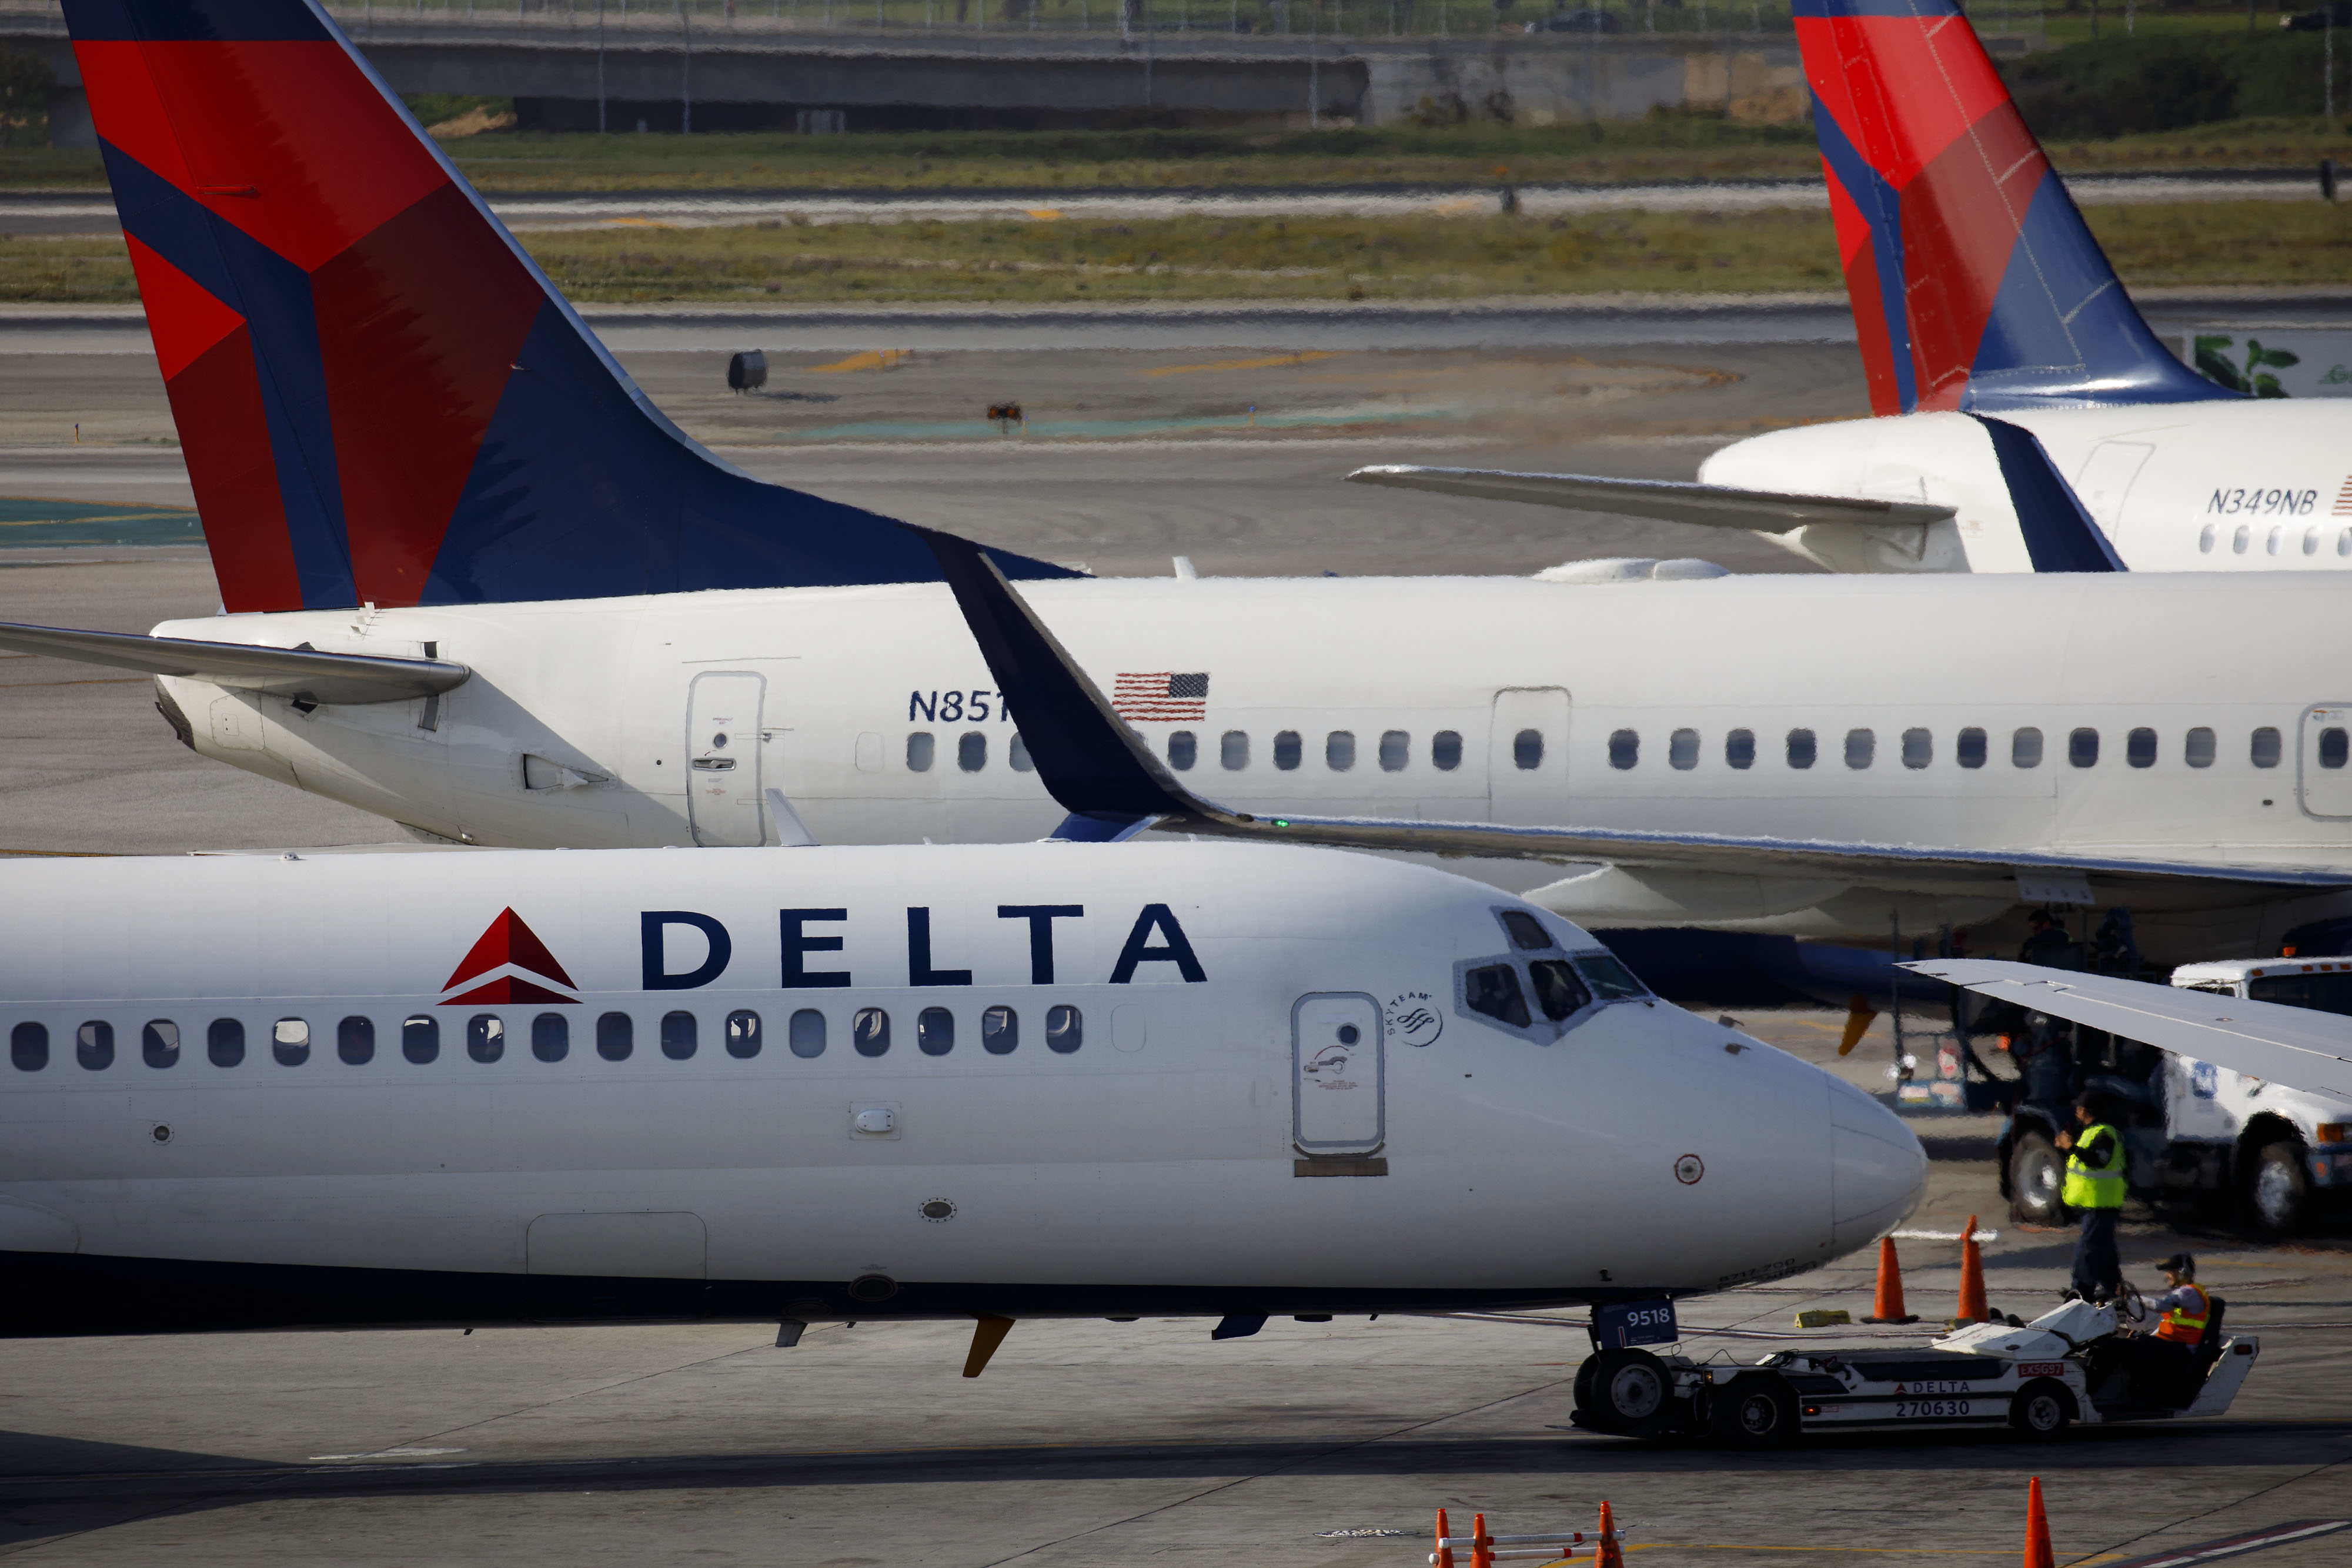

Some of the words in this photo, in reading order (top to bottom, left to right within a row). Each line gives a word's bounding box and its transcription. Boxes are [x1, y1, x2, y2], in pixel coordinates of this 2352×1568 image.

[2208, 488, 2317, 516] N349NB
[641, 903, 1208, 991] DELTA
[1385, 992, 1428, 1035] SKYTEAM
[1627, 1308, 1670, 1327] 9518
[1914, 1382, 1970, 1393] DELTA
[1896, 1400, 1969, 1417] 270630
